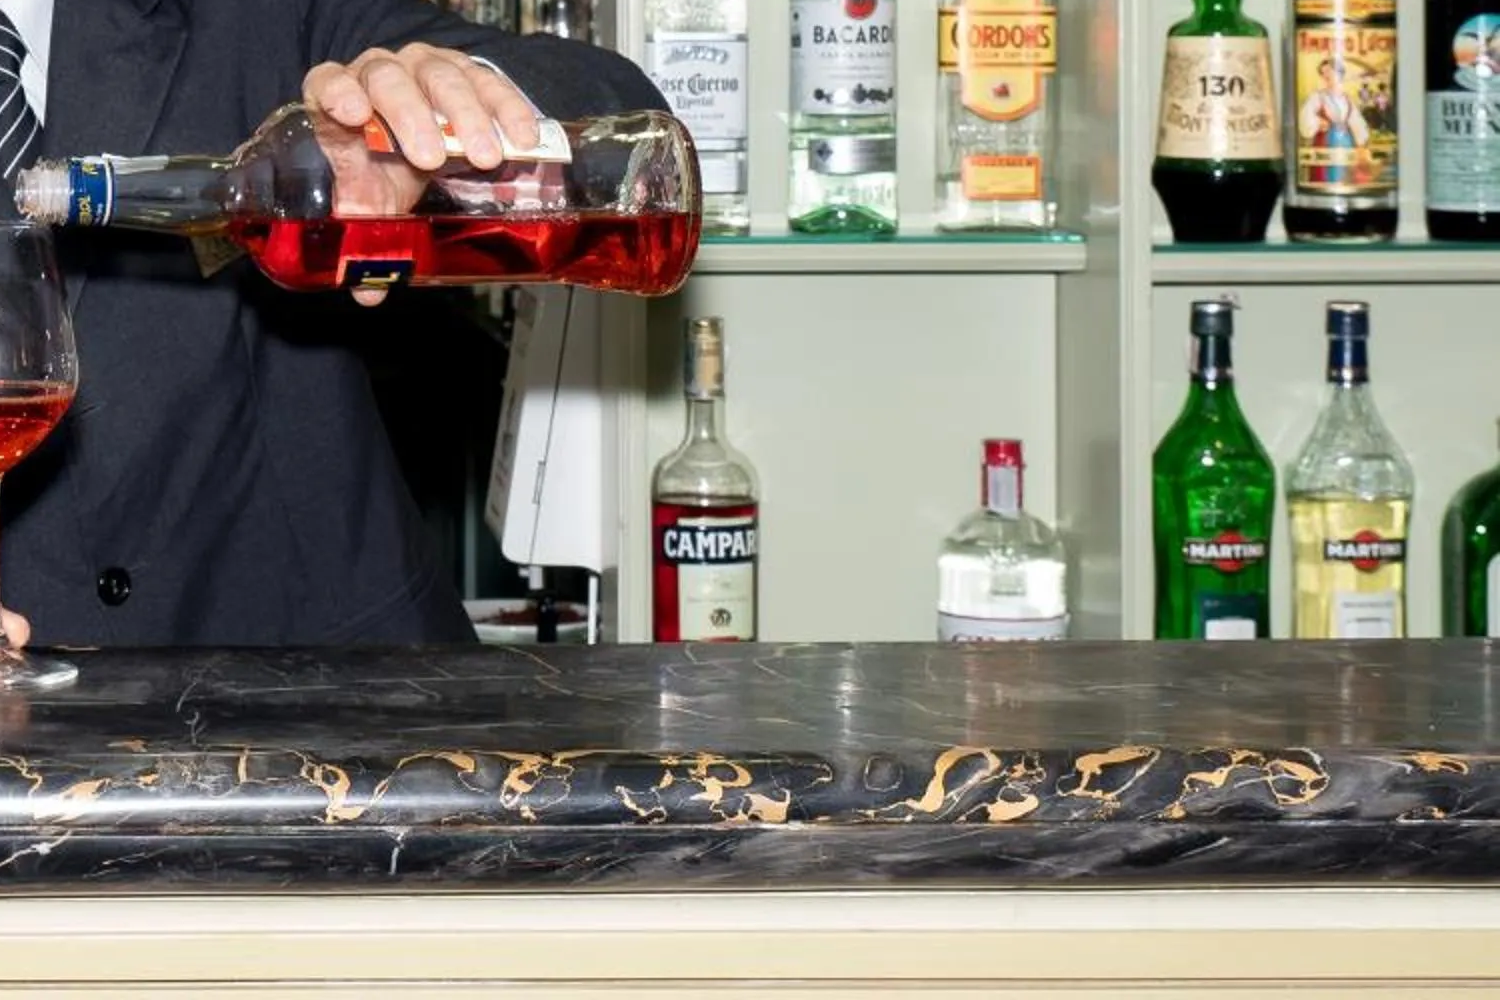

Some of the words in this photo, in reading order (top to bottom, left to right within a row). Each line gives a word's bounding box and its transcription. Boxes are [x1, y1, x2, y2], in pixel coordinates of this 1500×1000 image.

[812, 25, 893, 45] BACARD
[1198, 74, 1246, 98] 130
[663, 528, 757, 560] CAMPAR
